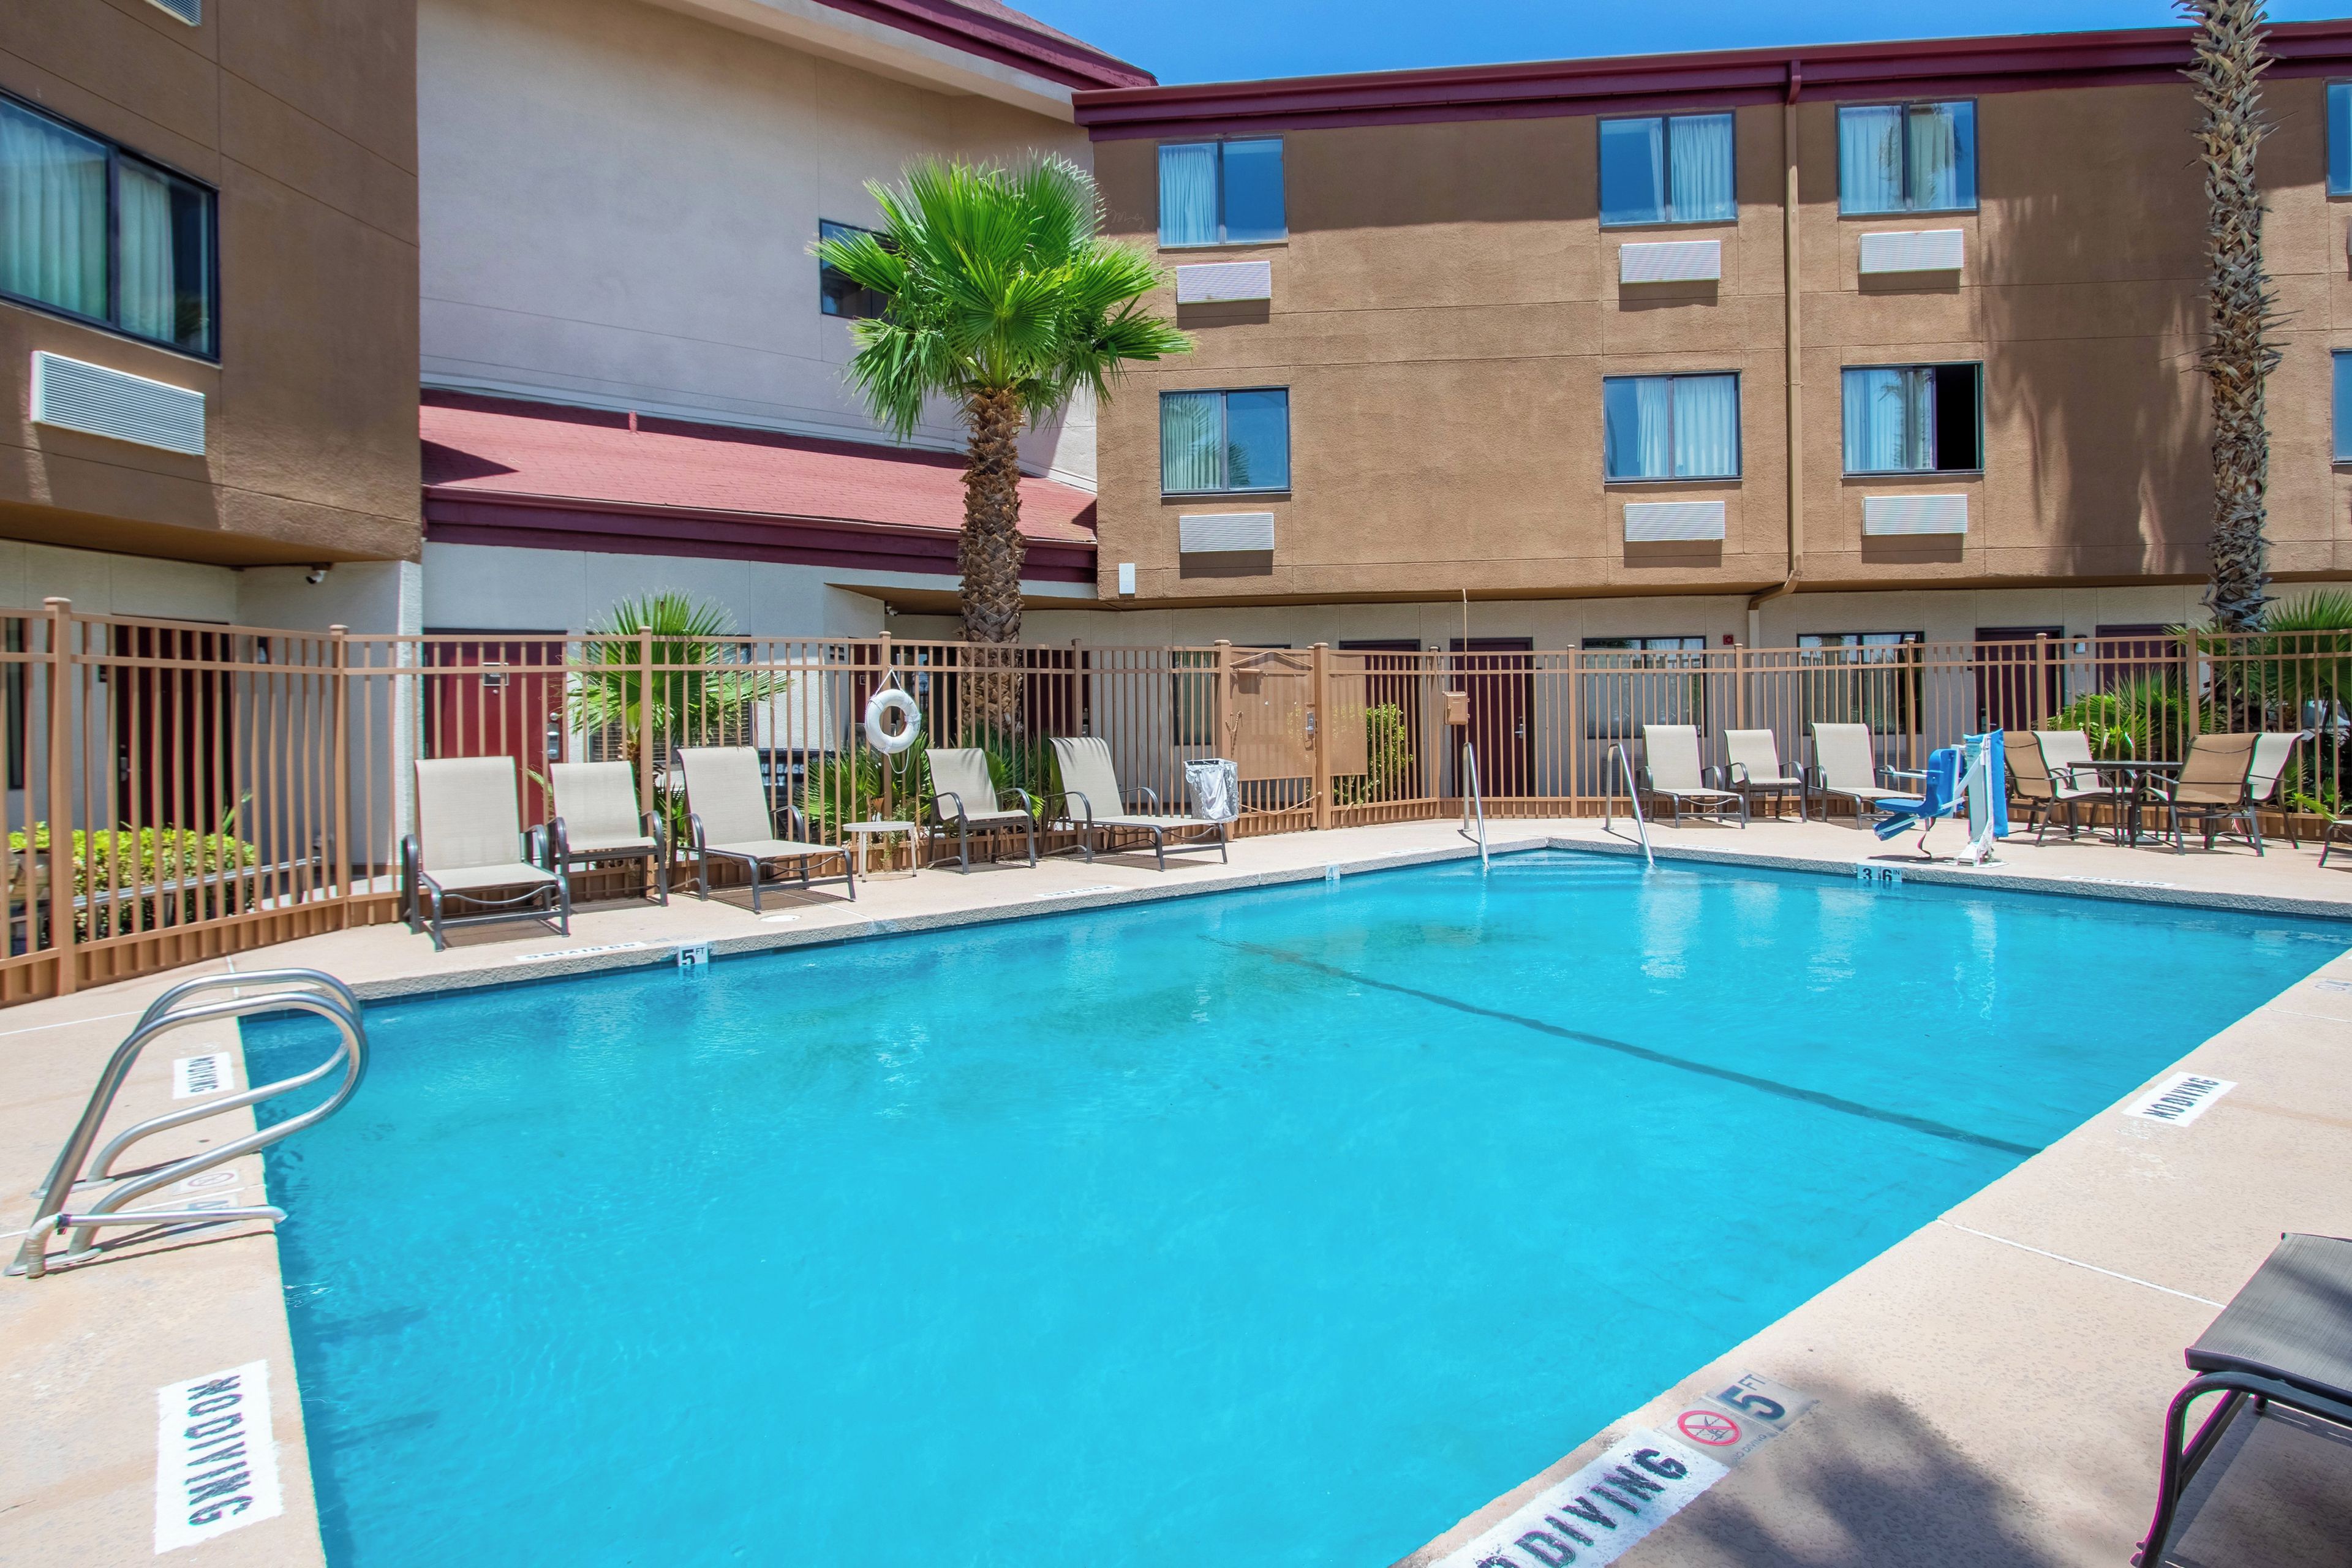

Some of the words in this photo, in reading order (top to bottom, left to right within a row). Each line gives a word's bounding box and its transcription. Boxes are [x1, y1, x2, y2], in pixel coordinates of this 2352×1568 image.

[1327, 867, 1333, 880] 4
[682, 949, 695, 965] 5
[1738, 1374, 1765, 1391] FT
[1716, 1385, 1785, 1420] 5
[1743, 1434, 1766, 1453] DIVING
[1514, 1448, 1688, 1568] DIVING
